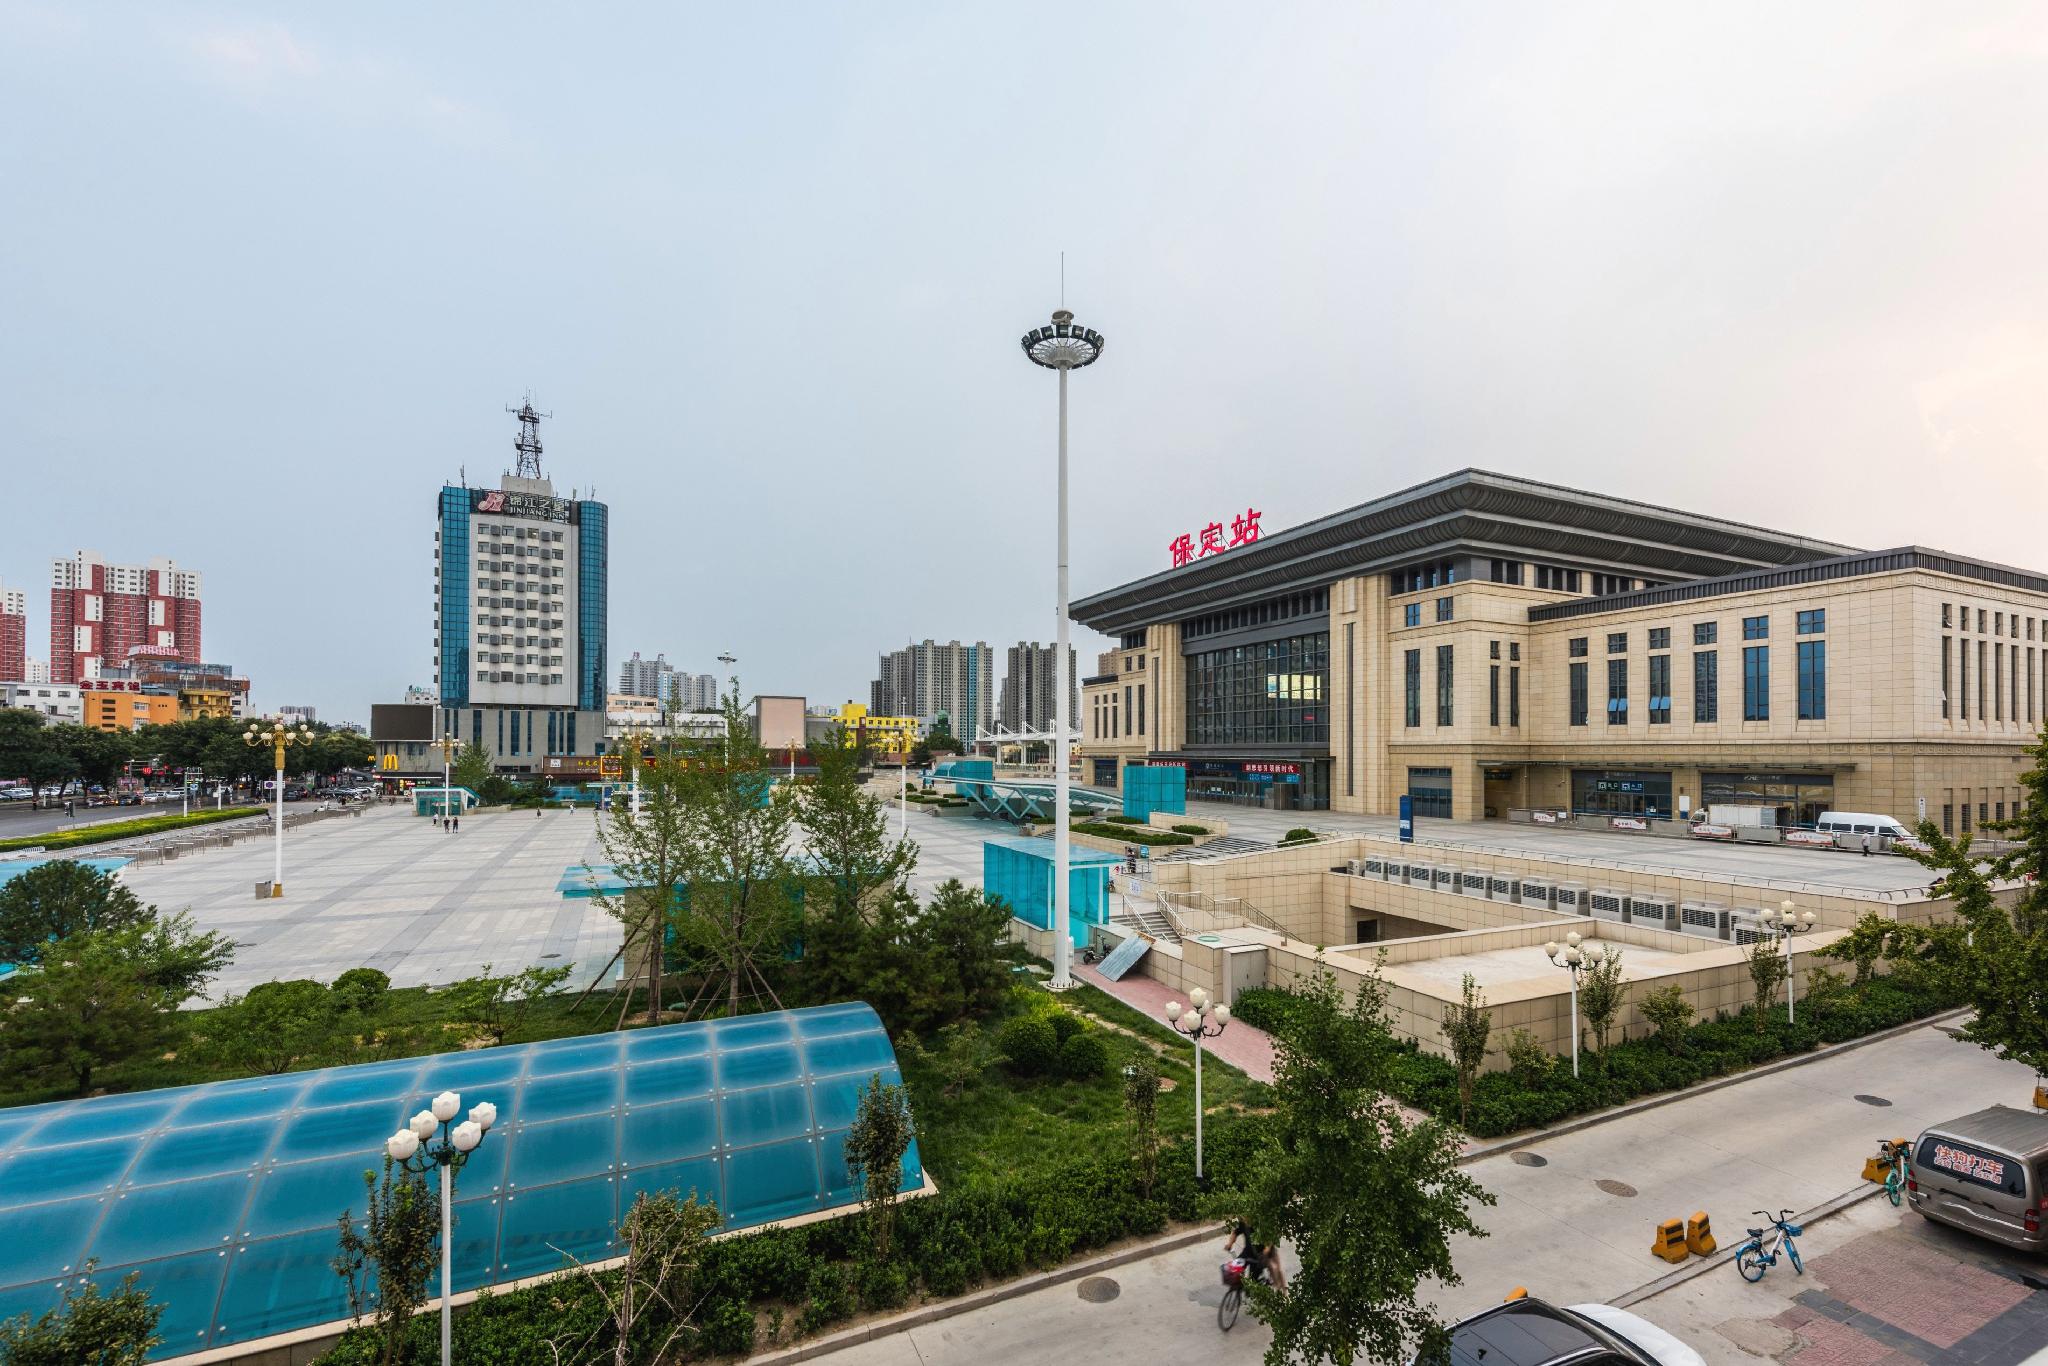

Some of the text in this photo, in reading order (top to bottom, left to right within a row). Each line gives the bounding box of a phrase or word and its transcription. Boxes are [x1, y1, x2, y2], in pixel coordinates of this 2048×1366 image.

[510, 507, 565, 520] JINJIANG INN
[1168, 507, 1262, 569] 保定站
[1934, 1144, 2005, 1175] 快狗打车
